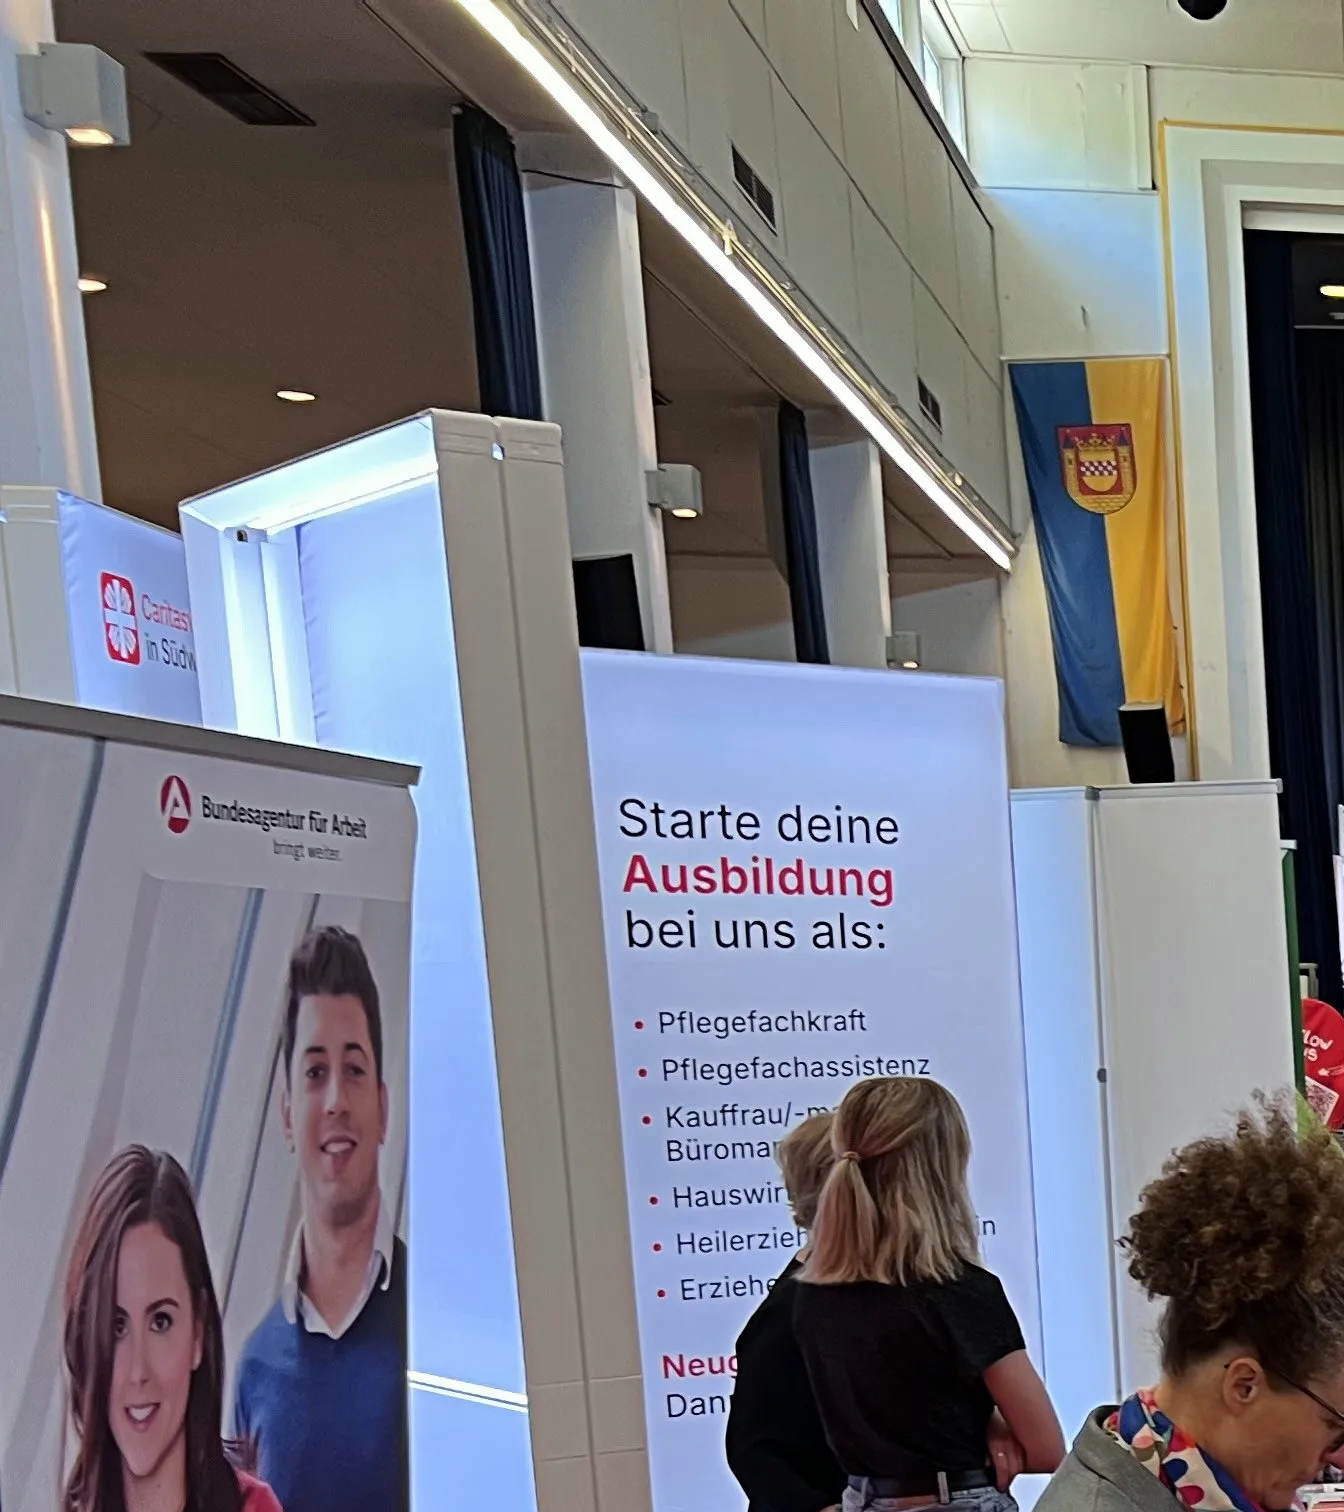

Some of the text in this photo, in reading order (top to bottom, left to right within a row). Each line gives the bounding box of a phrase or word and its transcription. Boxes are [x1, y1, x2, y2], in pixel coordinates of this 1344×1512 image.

[142, 593, 192, 632] Caritas
[145, 632, 196, 672] in Südw
[202, 795, 368, 839] Bundesagentur für Arbeit
[619, 797, 900, 845] Starte deine
[623, 854, 894, 907] Ausbildung
[626, 910, 887, 949] bei uns als:
[658, 1008, 868, 1039] Pflegefachkraft
[662, 1055, 931, 1087] Pflegefachassistenz
[666, 1138, 782, 1162] Büroma
[673, 1181, 786, 1208] Hauswir
[677, 1226, 808, 1255] Heilerzieh
[680, 1274, 777, 1301] Erziehe
[666, 1392, 732, 1418] Dan
